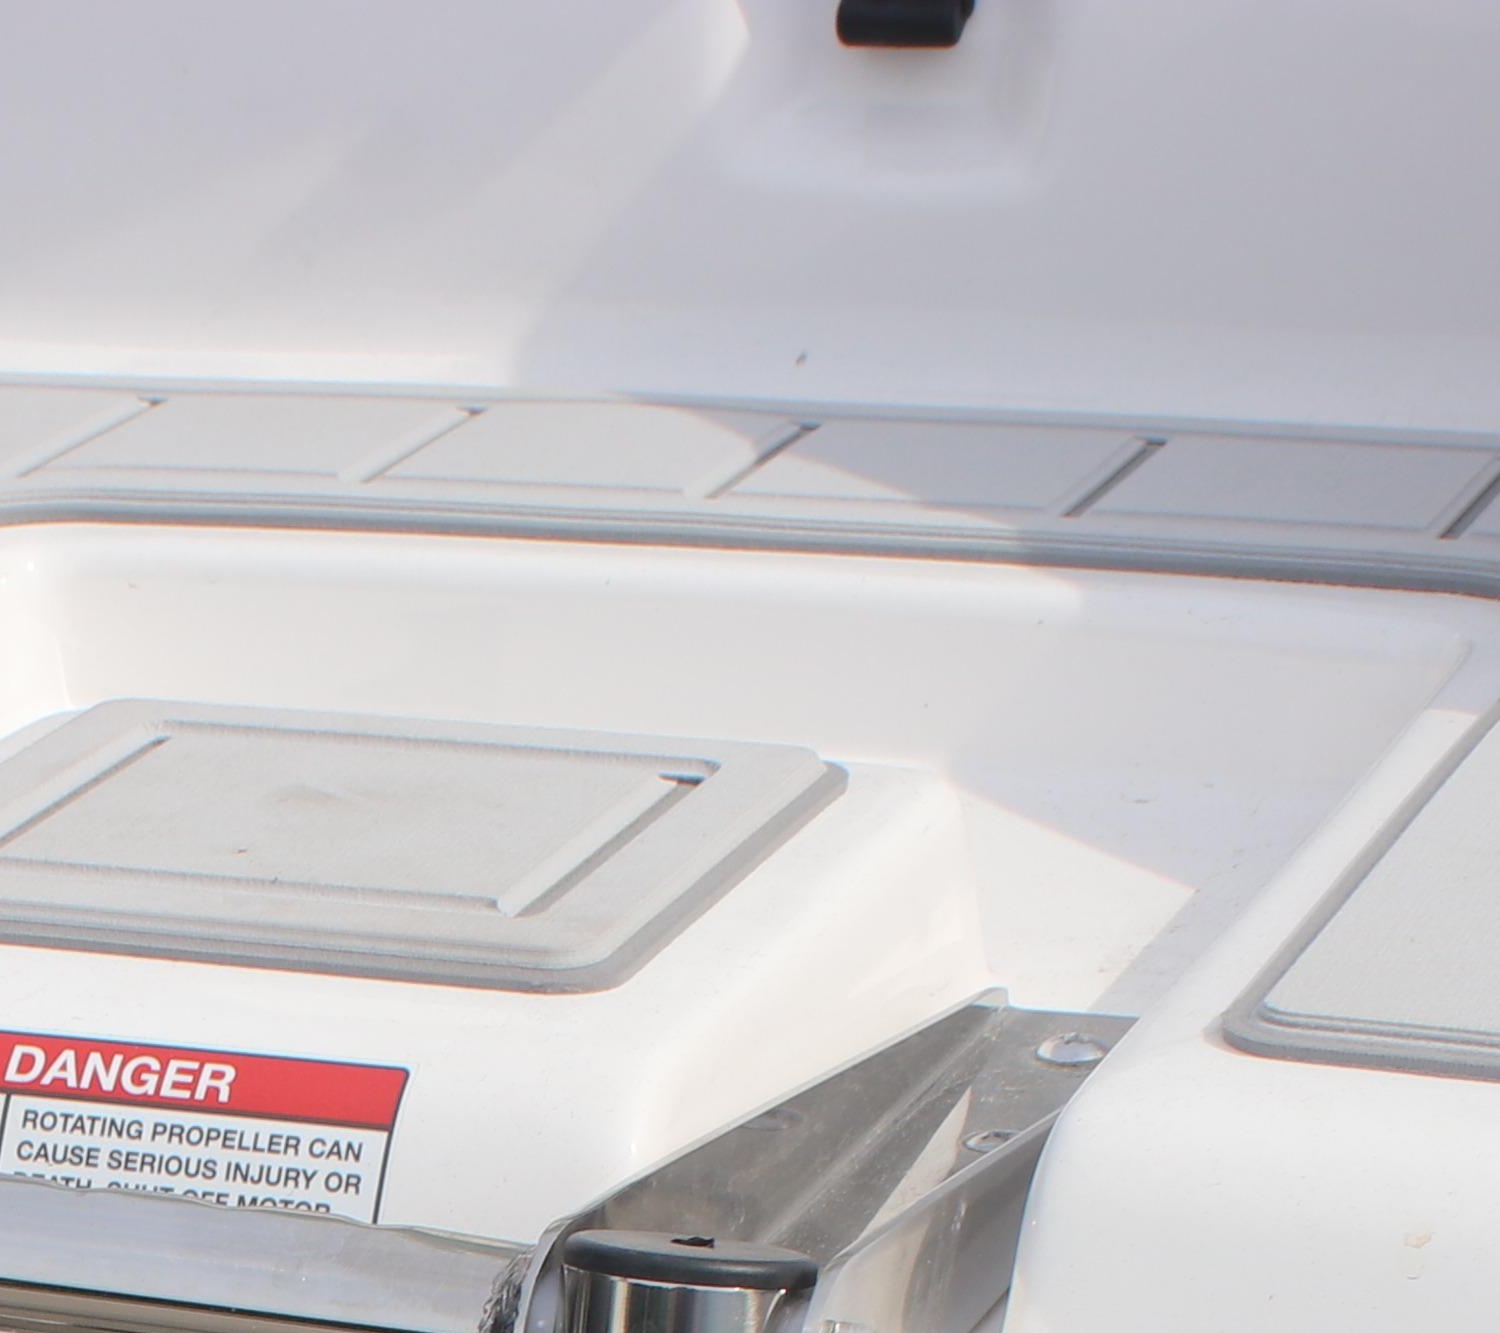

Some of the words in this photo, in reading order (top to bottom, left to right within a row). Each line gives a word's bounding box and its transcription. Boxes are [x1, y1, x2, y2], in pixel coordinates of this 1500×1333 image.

[4, 1043, 236, 1103] DANGER
[20, 1109, 144, 1147] ROTATING
[149, 1122, 302, 1157] PROPELLER
[308, 1136, 364, 1163] CAN
[15, 1140, 102, 1171] CAUSE
[106, 1148, 218, 1182] SERIOUS
[224, 1160, 321, 1192] INJURY
[323, 1169, 362, 1196] OR
